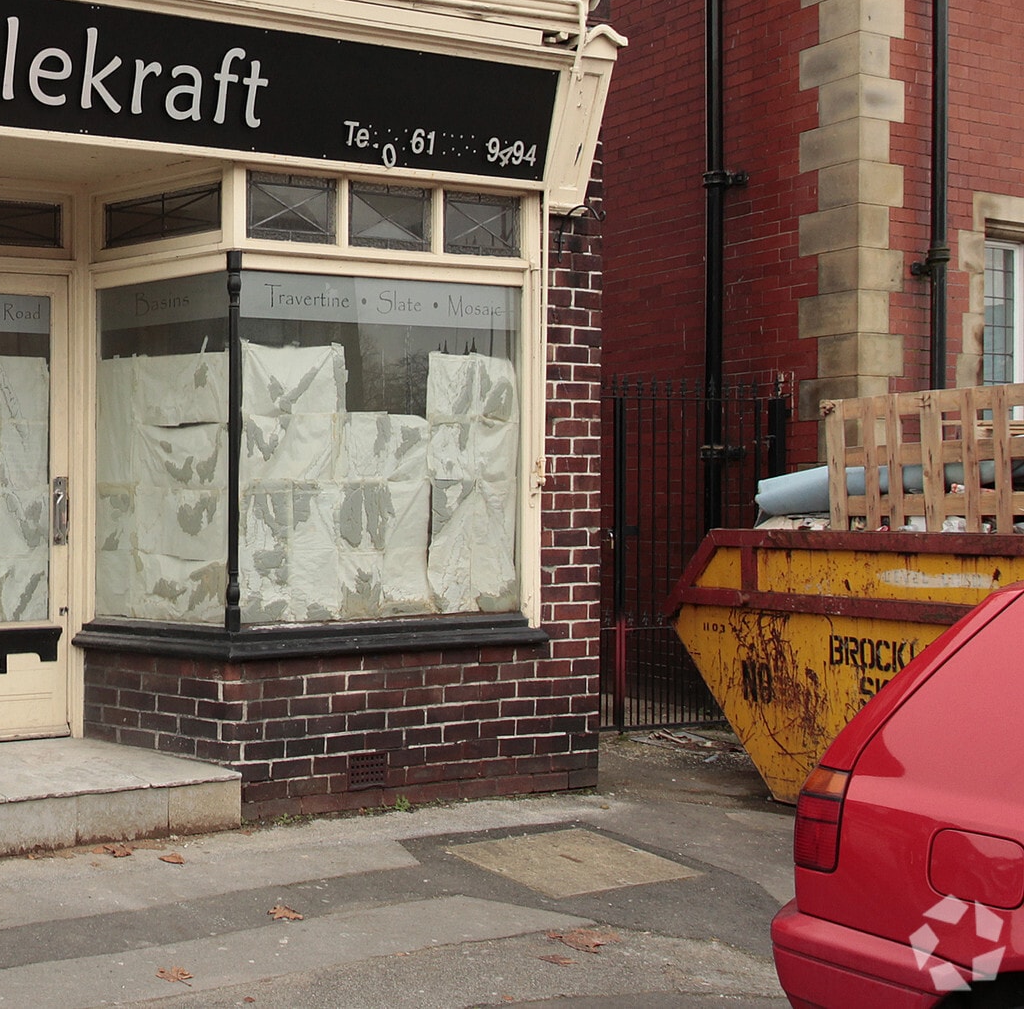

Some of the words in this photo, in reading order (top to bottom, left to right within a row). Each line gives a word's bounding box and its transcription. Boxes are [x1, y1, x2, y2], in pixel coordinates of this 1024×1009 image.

[2, 302, 42, 321] Road
[134, 291, 191, 317] Basins
[264, 283, 351, 308] Travertine
[376, 290, 423, 315] Slate
[448, 294, 503, 319] Mosaic
